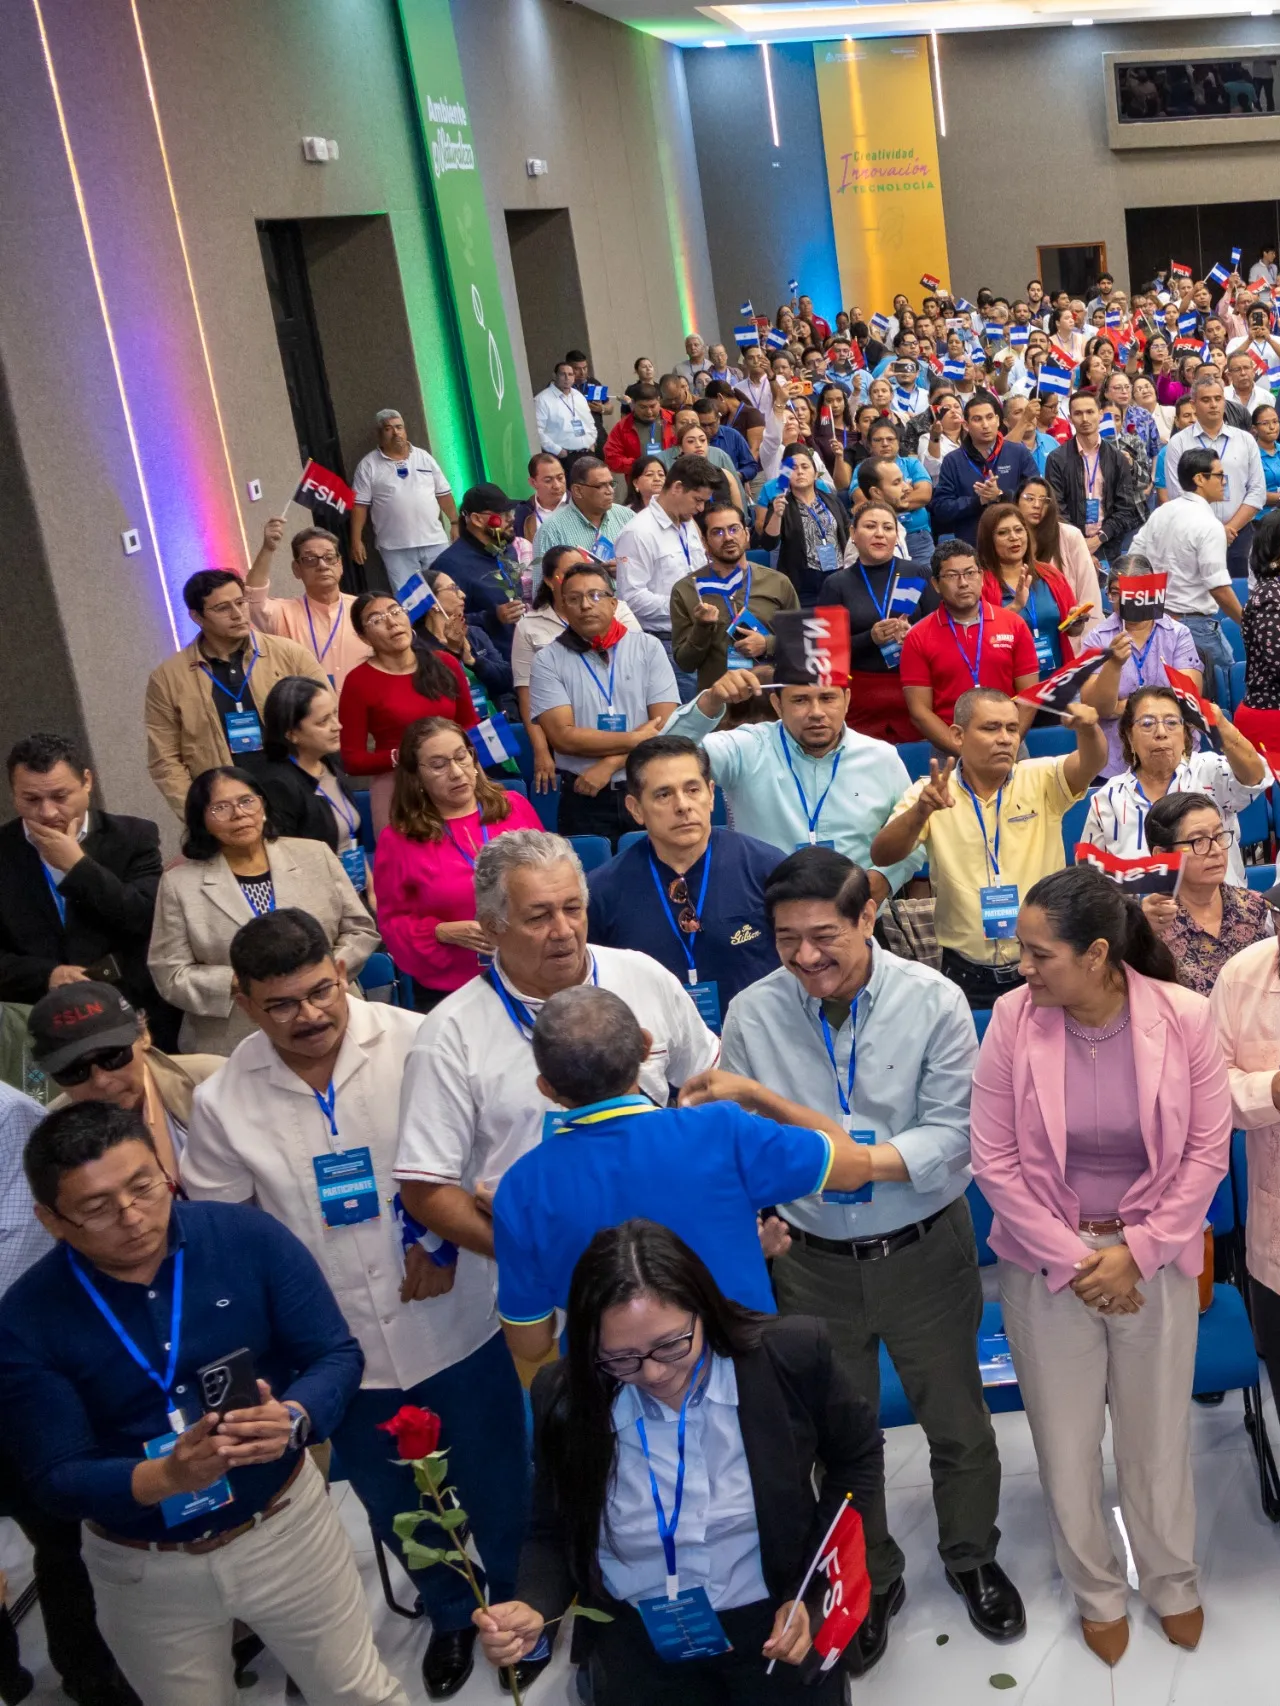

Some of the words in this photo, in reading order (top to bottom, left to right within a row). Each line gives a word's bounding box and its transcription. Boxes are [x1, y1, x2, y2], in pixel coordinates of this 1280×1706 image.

[427, 95, 467, 126] Ambiente
[854, 149, 914, 162] Creatividad
[837, 153, 930, 194] Innovación
[852, 181, 935, 194] TECNOLOGÍA
[302, 478, 346, 514] FSLN
[1120, 588, 1166, 607] FSLN
[984, 908, 1018, 918] PARTICIPANTE
[730, 929, 761, 945] Gibson
[53, 1000, 104, 1030] FSLN
[322, 1179, 373, 1198] PARTICIPANTE
